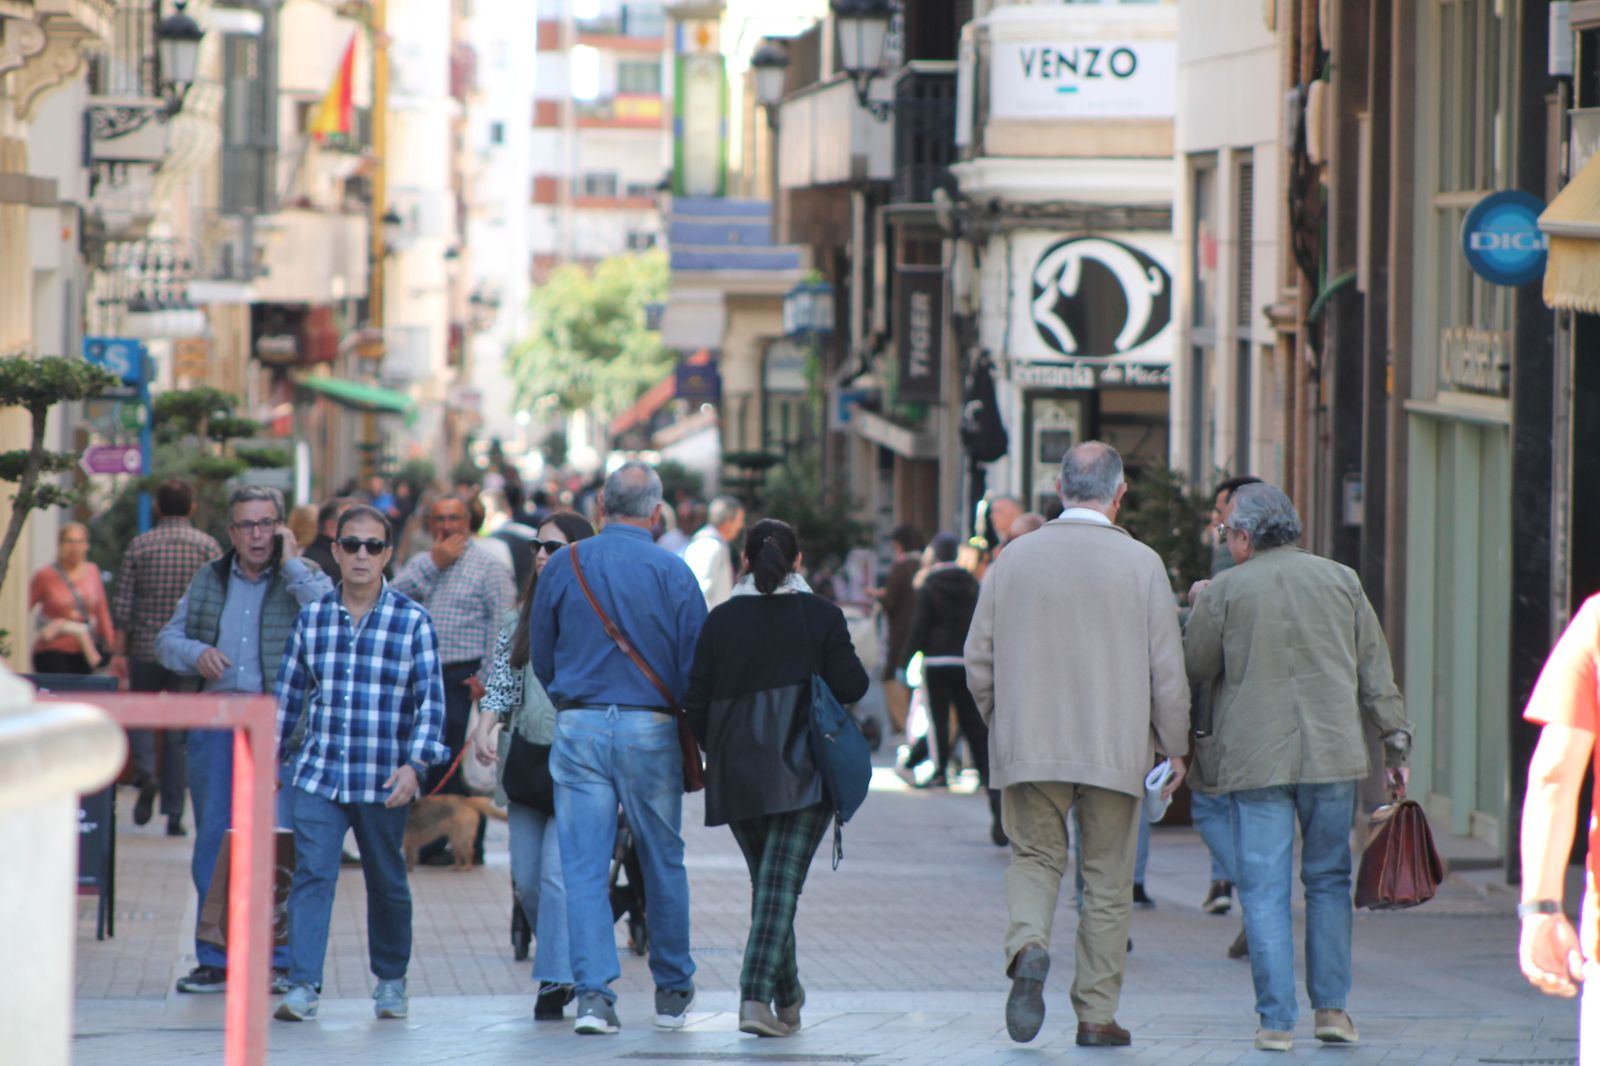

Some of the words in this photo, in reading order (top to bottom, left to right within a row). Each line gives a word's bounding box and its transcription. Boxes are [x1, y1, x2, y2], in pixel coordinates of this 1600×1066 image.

[1019, 47, 1138, 80] VENZO
[1470, 231, 1549, 251] DIGI
[909, 291, 932, 378] TIGER
